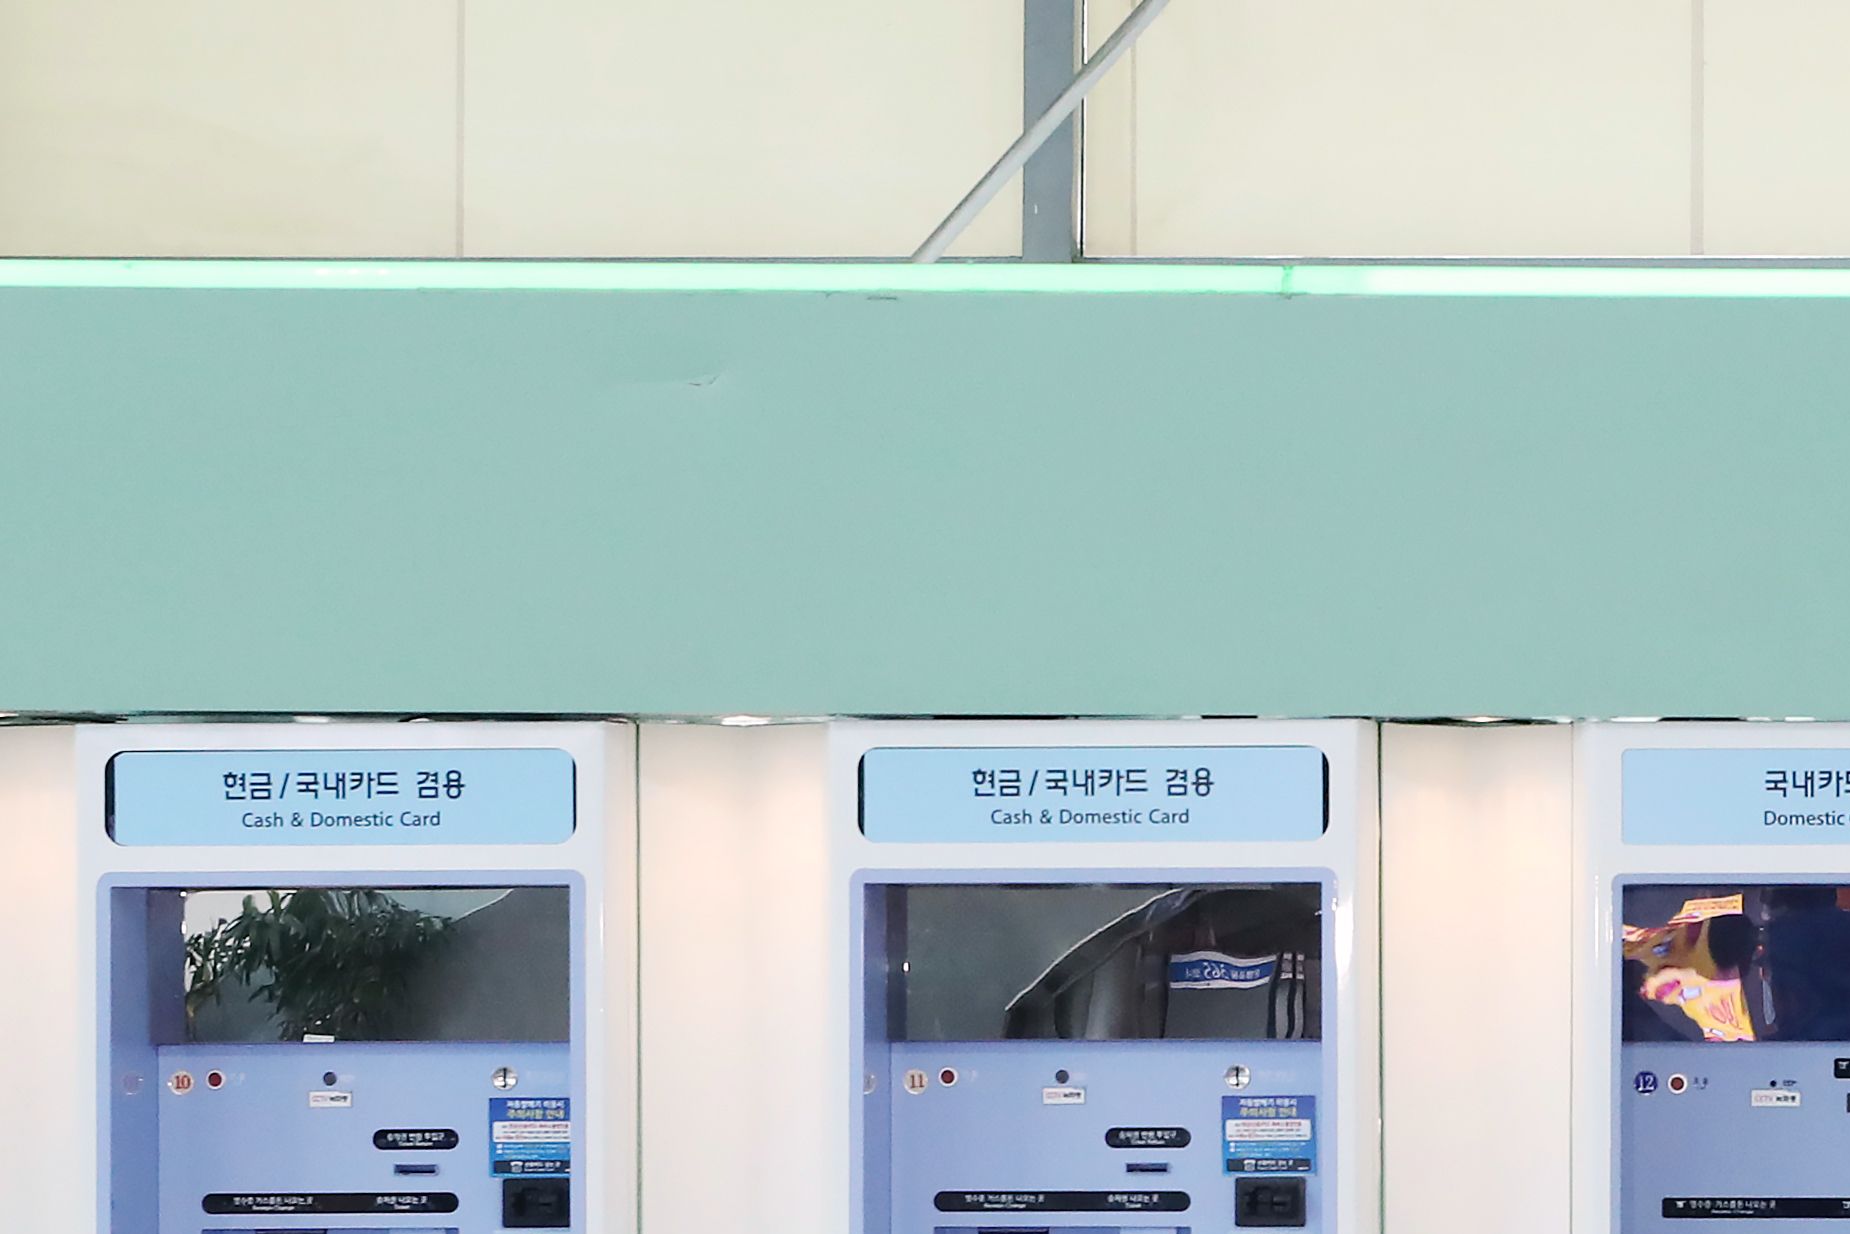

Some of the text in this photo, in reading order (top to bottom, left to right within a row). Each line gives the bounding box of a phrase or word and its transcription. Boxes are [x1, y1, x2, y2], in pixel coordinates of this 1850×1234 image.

[416, 769, 465, 800] 겸용
[1165, 767, 1214, 798] 겸용
[241, 811, 441, 828] Cash & Domestic Card
[990, 808, 1190, 825] Cash & Domestic Card
[1763, 809, 1845, 827] Domestic
[175, 1075, 191, 1090] 10
[909, 1074, 925, 1088] 11
[1638, 1075, 1655, 1091] 12
